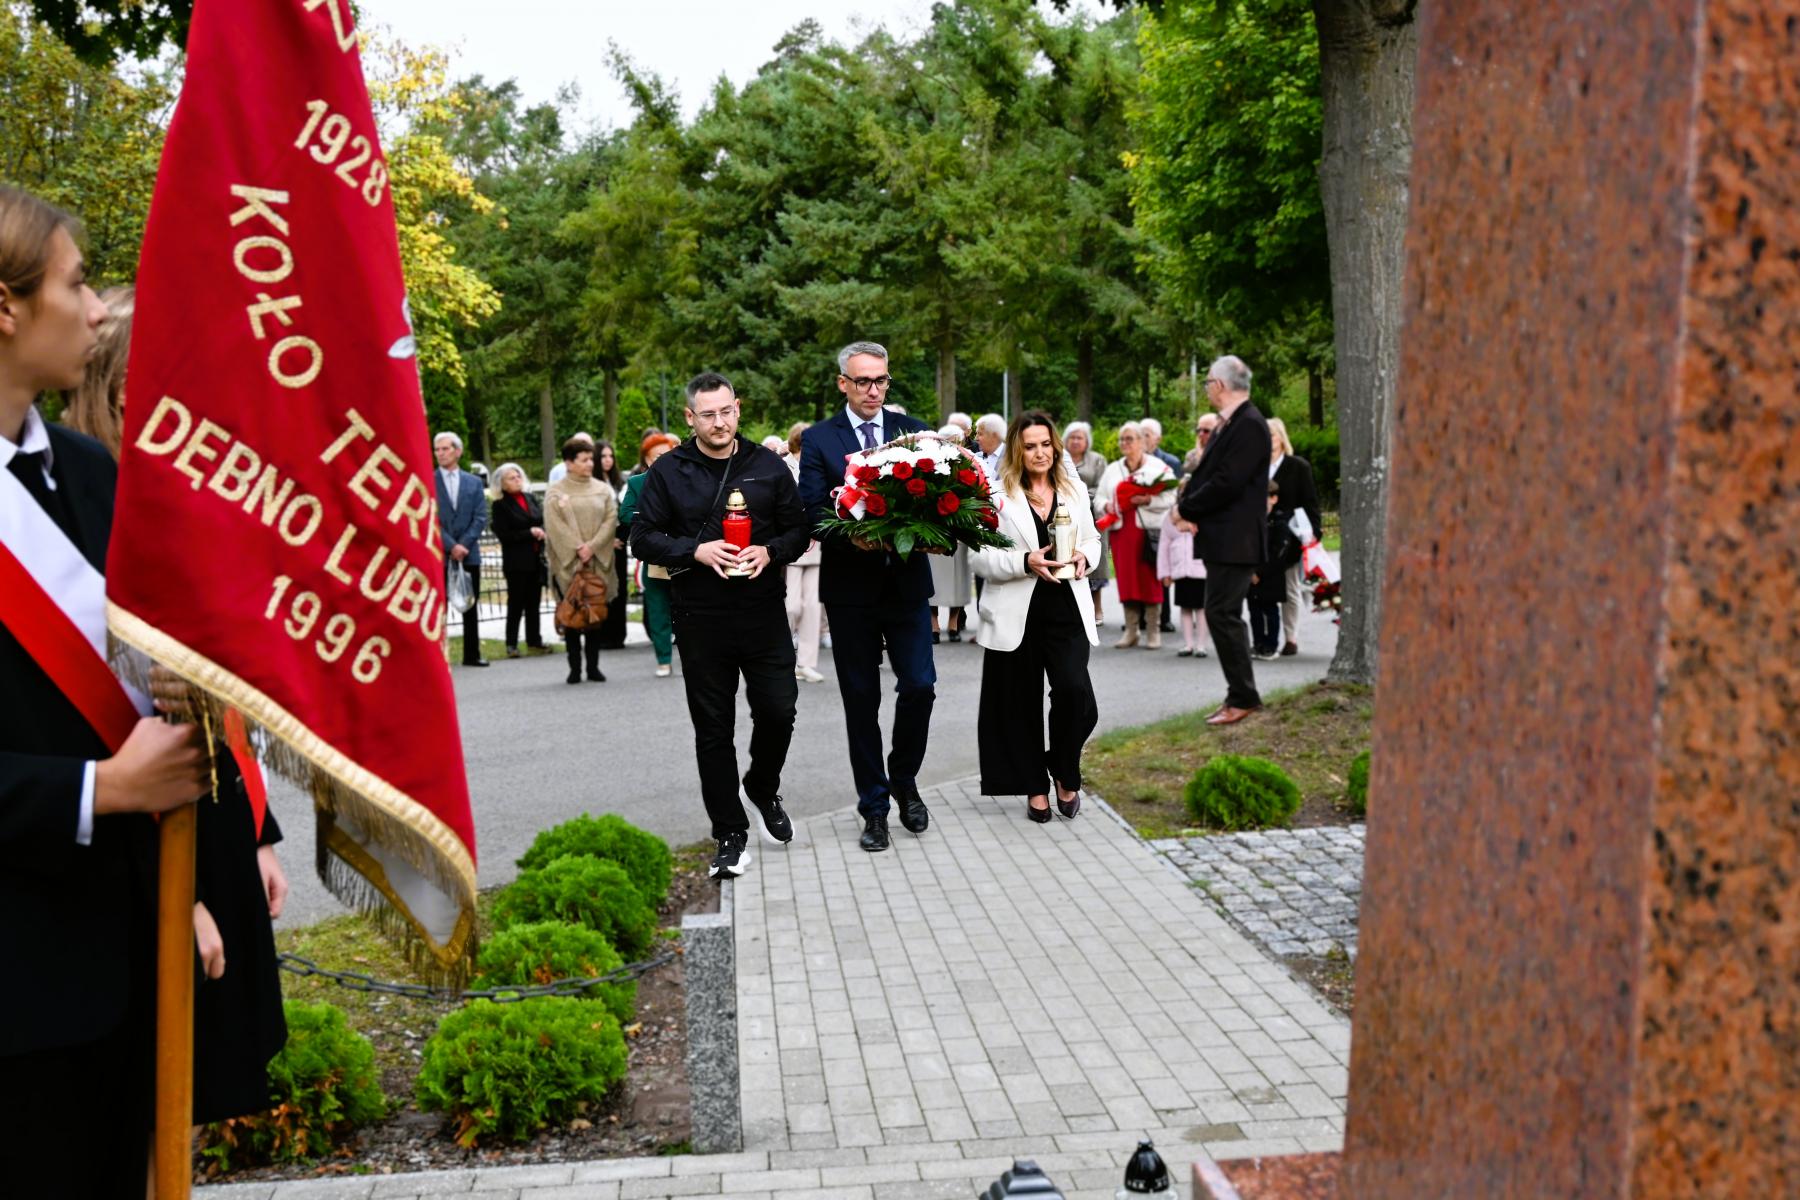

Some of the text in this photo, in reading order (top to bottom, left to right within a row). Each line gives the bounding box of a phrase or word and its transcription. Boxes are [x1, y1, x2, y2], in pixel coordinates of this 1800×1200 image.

[294, 99, 387, 207] 1928
[229, 184, 323, 388] KOŁO
[135, 396, 323, 546] DĘBNO
[264, 575, 391, 683] 1996
